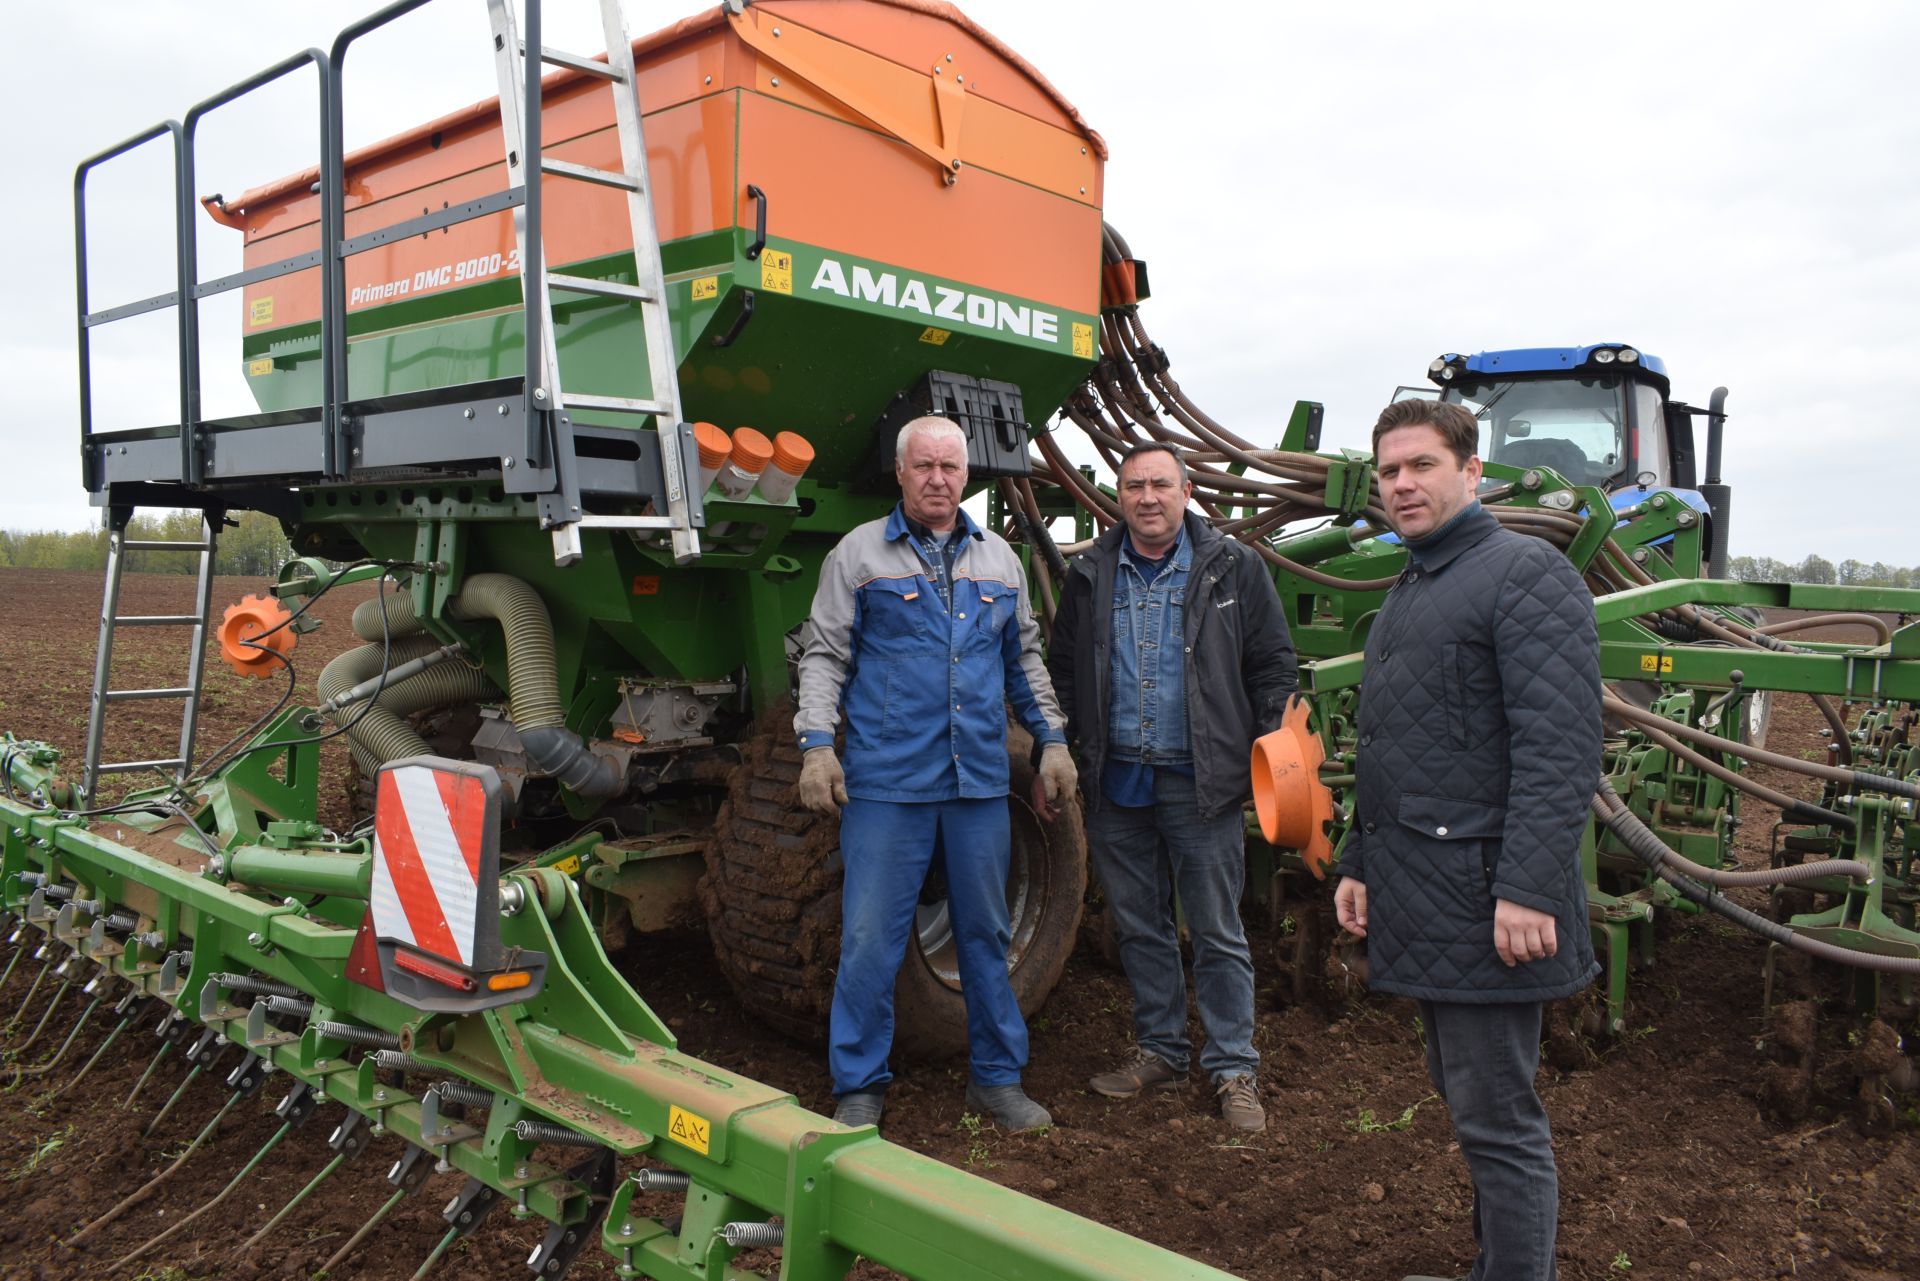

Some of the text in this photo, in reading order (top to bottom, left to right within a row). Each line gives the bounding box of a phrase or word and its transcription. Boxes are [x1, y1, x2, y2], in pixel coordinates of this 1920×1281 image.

[350, 278, 410, 306] Primera
[413, 265, 452, 292] DMC
[811, 258, 1058, 343] AMAZONE
